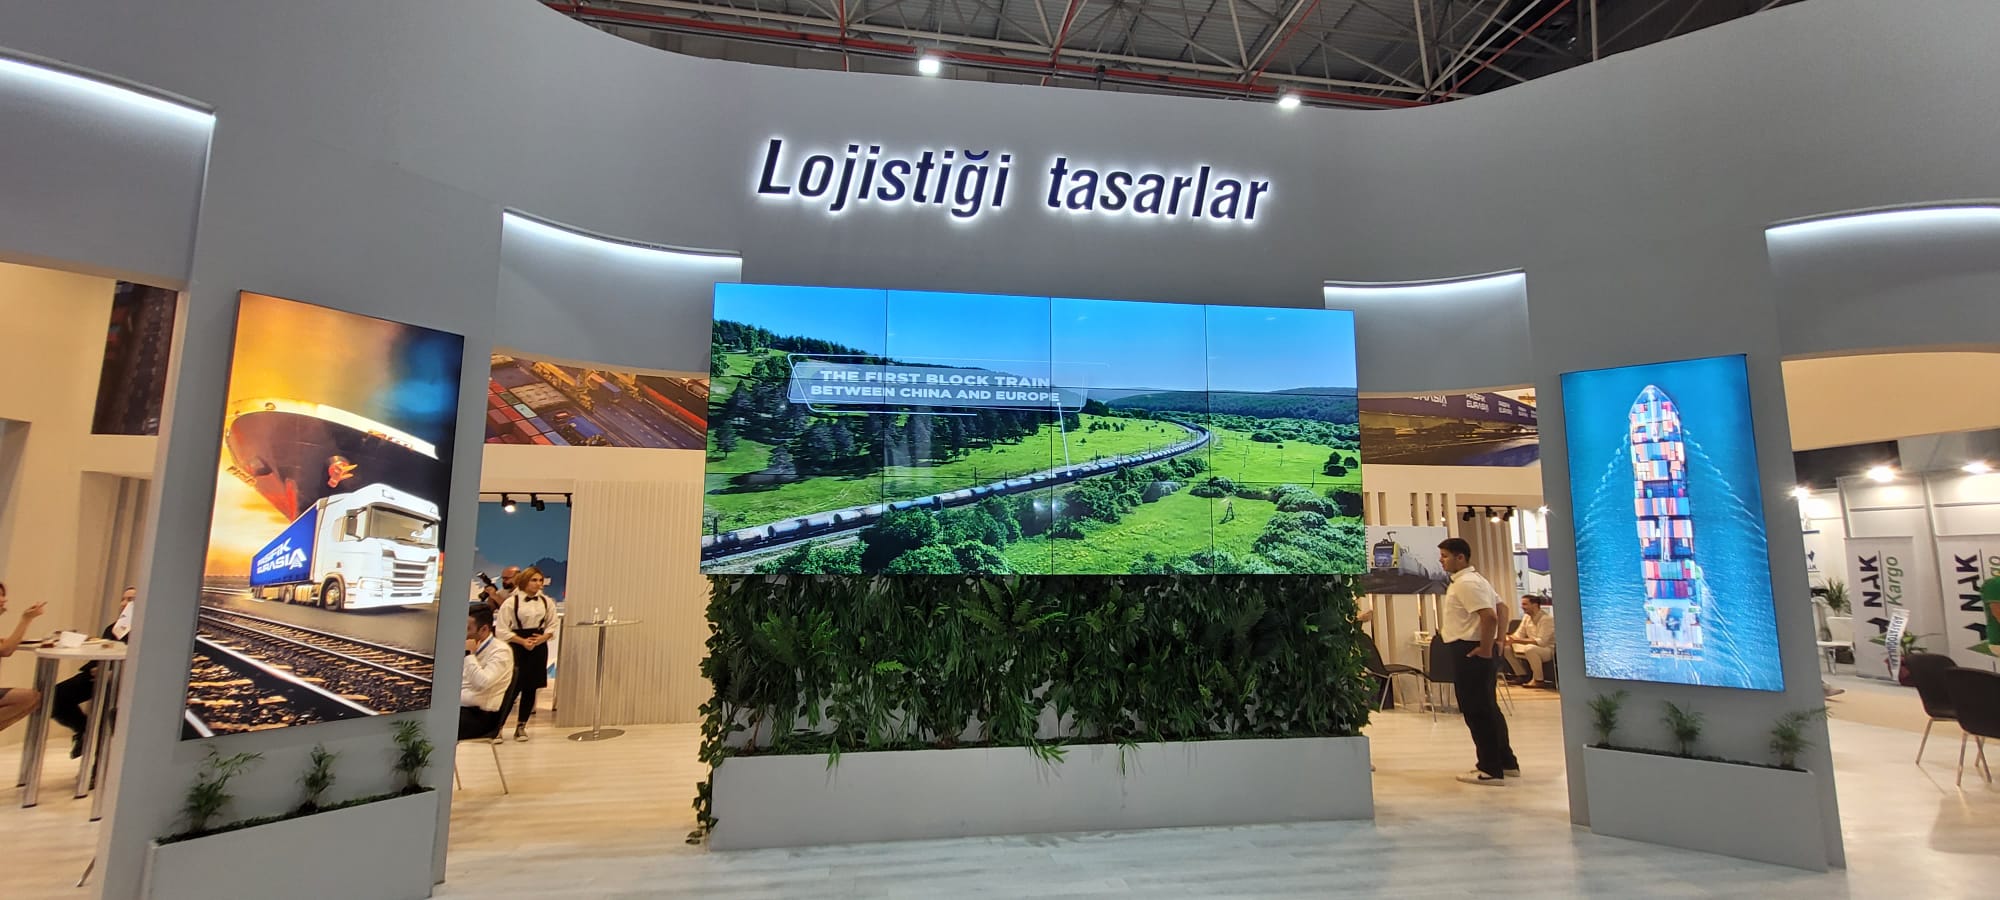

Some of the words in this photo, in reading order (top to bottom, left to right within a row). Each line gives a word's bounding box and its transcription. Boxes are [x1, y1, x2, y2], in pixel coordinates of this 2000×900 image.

[757, 139, 1012, 218] Lojistiği
[1047, 157, 1268, 220] tasarlar
[811, 385, 895, 398] BETWEEN
[900, 387, 951, 399] CHINA
[956, 389, 991, 400] AND
[996, 391, 1060, 403] EUROPE
[820, 370, 860, 382] THE
[865, 371, 920, 385] FIRST
[926, 374, 989, 387] BLOCK
[994, 375, 1050, 388] TRAIN
[1858, 555, 1882, 608] NAK
[1886, 556, 1904, 606] Kargo
[1955, 554, 1985, 612] NAK
